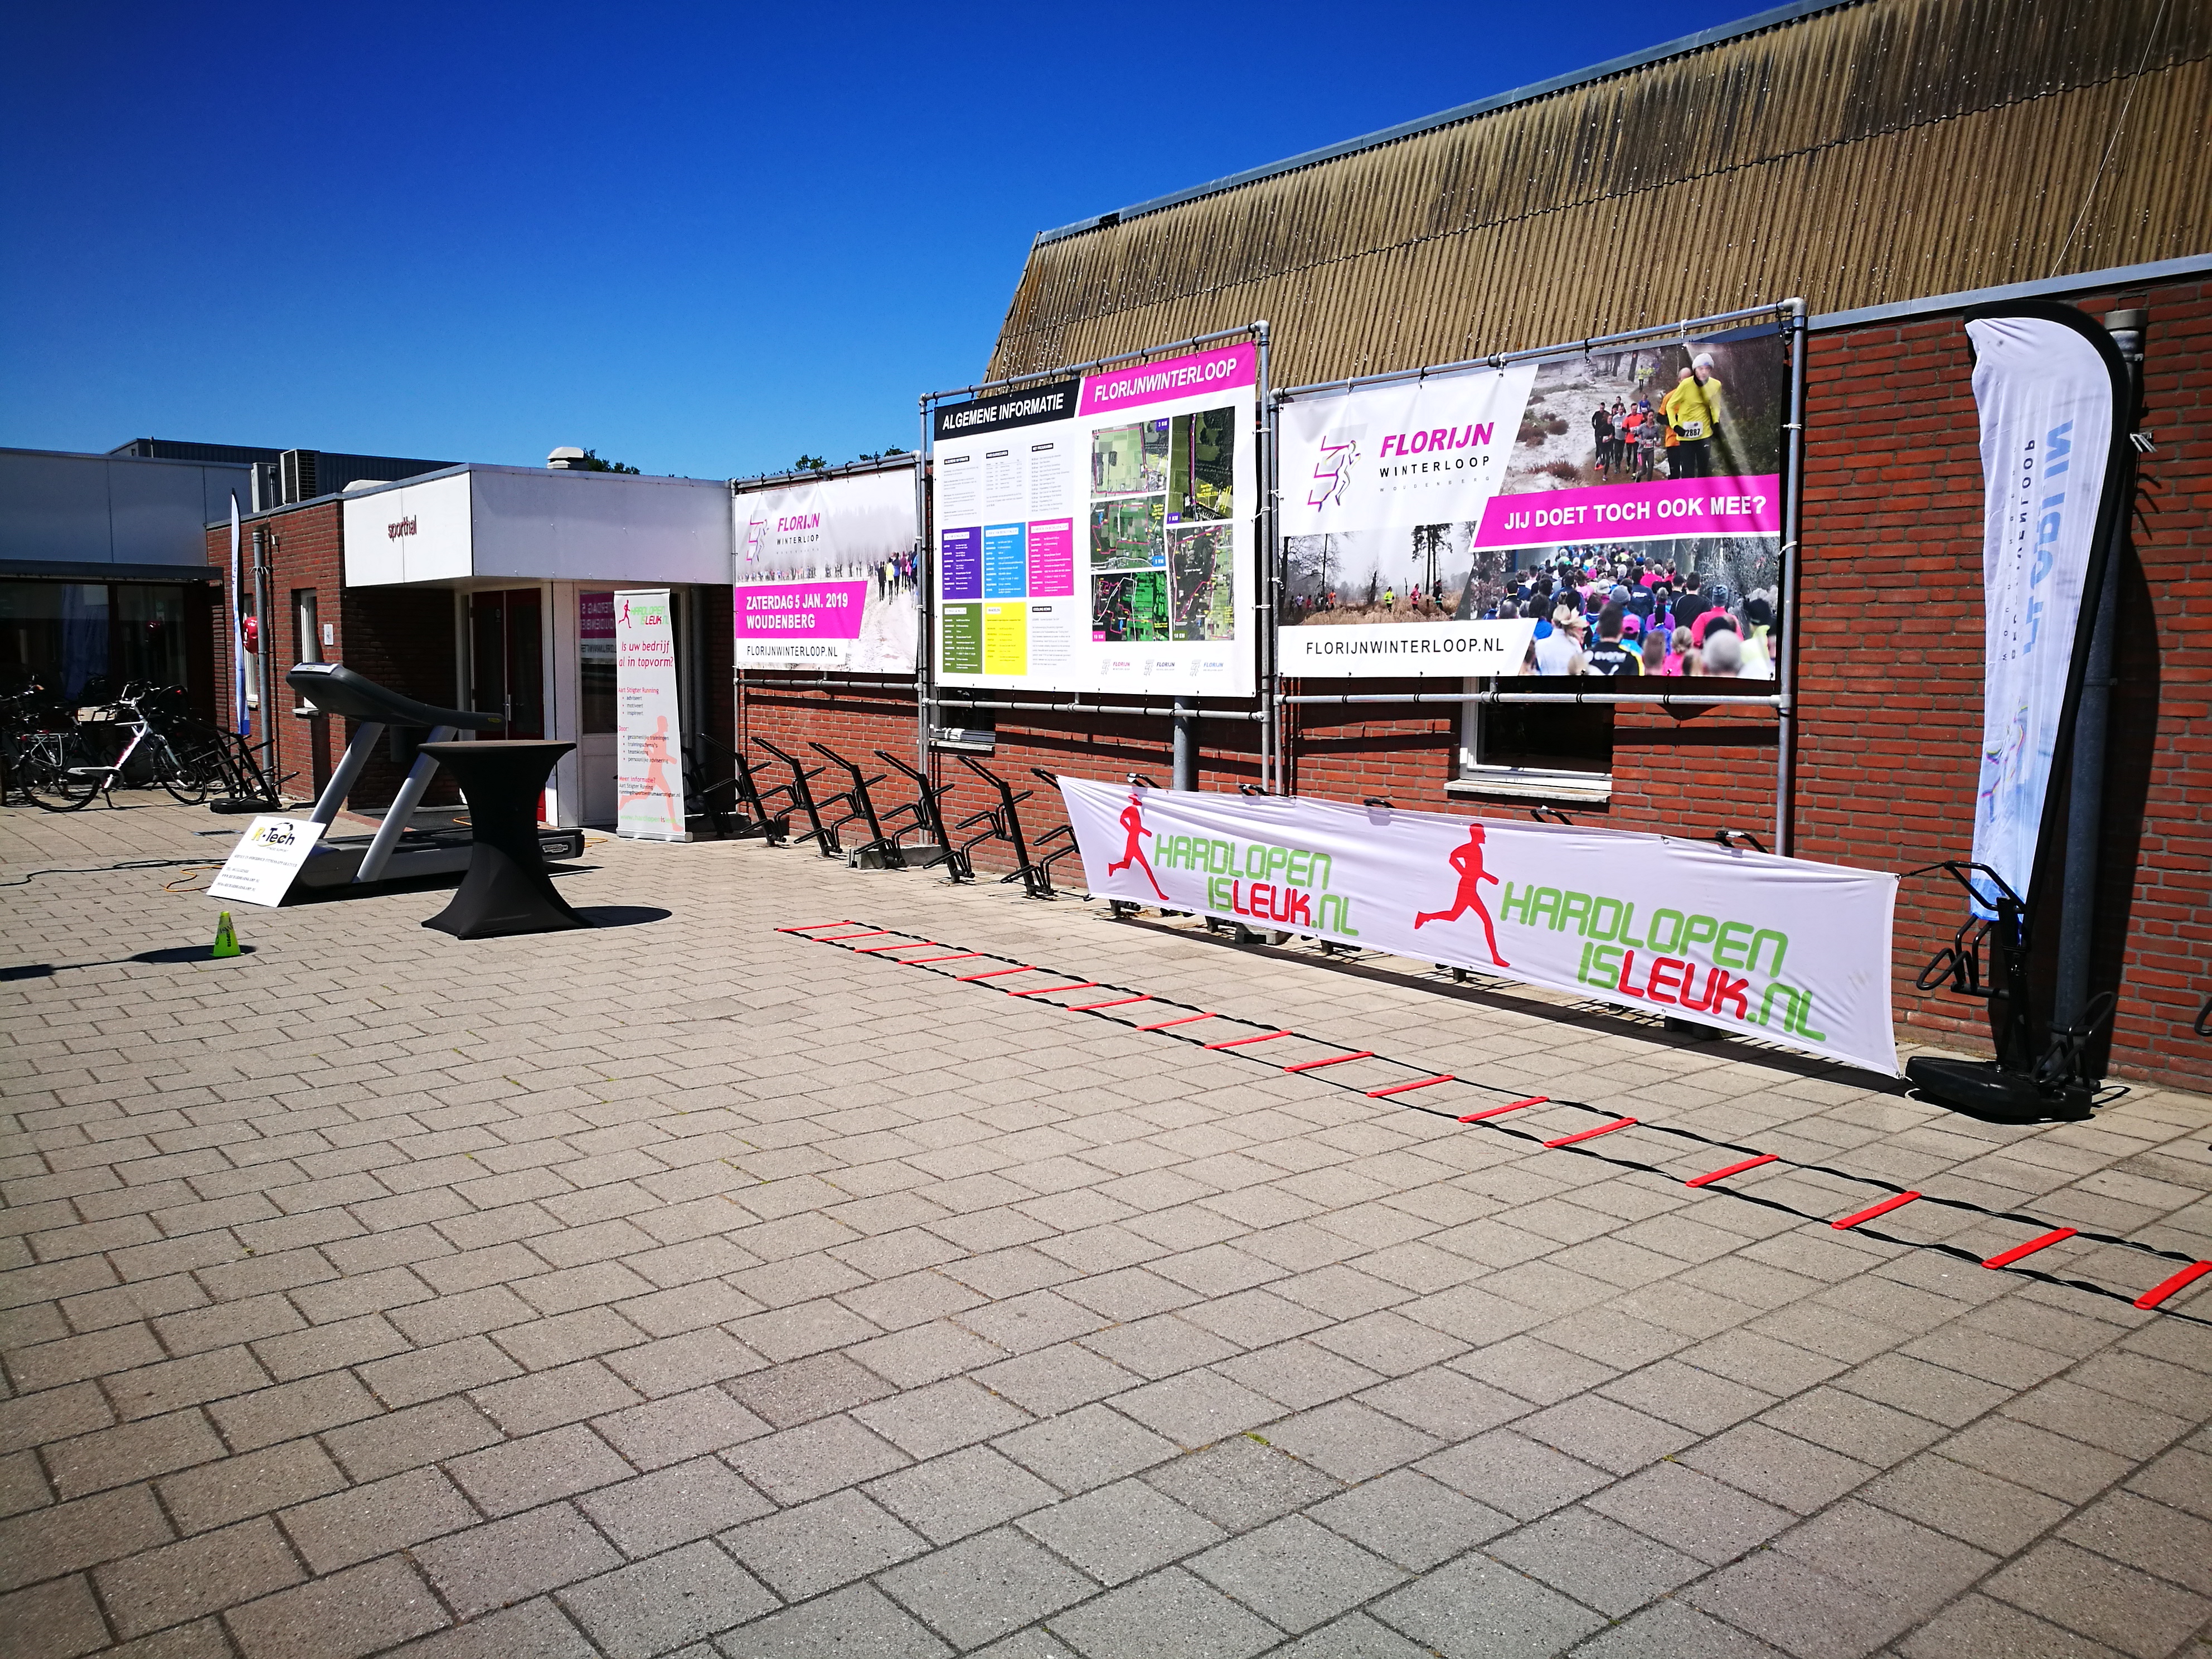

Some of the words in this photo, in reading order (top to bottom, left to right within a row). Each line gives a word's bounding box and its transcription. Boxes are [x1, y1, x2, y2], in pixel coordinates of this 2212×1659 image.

[1094, 358, 1237, 402] FLORIJNWINTERLOOP
[942, 406, 997, 430] ALGEMENE
[999, 393, 1064, 420] INFORMATIE
[1380, 422, 1495, 458] FLORIJN
[1380, 456, 1489, 478] WINTERLOOP
[1380, 477, 1490, 492] WOUDENBERG
[777, 512, 820, 532] FLORIJN
[1503, 511, 1529, 530] JIJ
[1535, 506, 1588, 528] DOET
[1593, 501, 1651, 524] TOCH
[1657, 497, 1704, 518] OOK
[1711, 495, 1767, 516] MEE?
[388, 515, 417, 542] sporthal
[777, 534, 819, 545] WINTERLOOP
[630, 606, 665, 616] HARDLOPEN
[746, 594, 794, 610] ZATERDAG
[795, 594, 800, 609] 5
[802, 593, 823, 609] JAN.
[826, 593, 848, 608] 2019
[746, 613, 816, 629] WOUDENBERG
[622, 642, 627, 651] Is
[642, 641, 670, 653] bedrijf
[747, 646, 838, 657] FLORIJNWINTERLOOP.NL
[1307, 638, 1504, 654] FLORIJNWINTERLOOP.NL
[619, 657, 625, 667] al
[628, 656, 635, 667] in
[638, 657, 673, 669] topvorm?
[251, 826, 295, 846] R-Tech
[1154, 833, 1332, 890] HARDLOPEN
[1208, 876, 1359, 937] ISLEUK.NL
[1500, 881, 1789, 978] HARDLOPEN
[1578, 942, 1826, 1042] ISLEUK.NL
